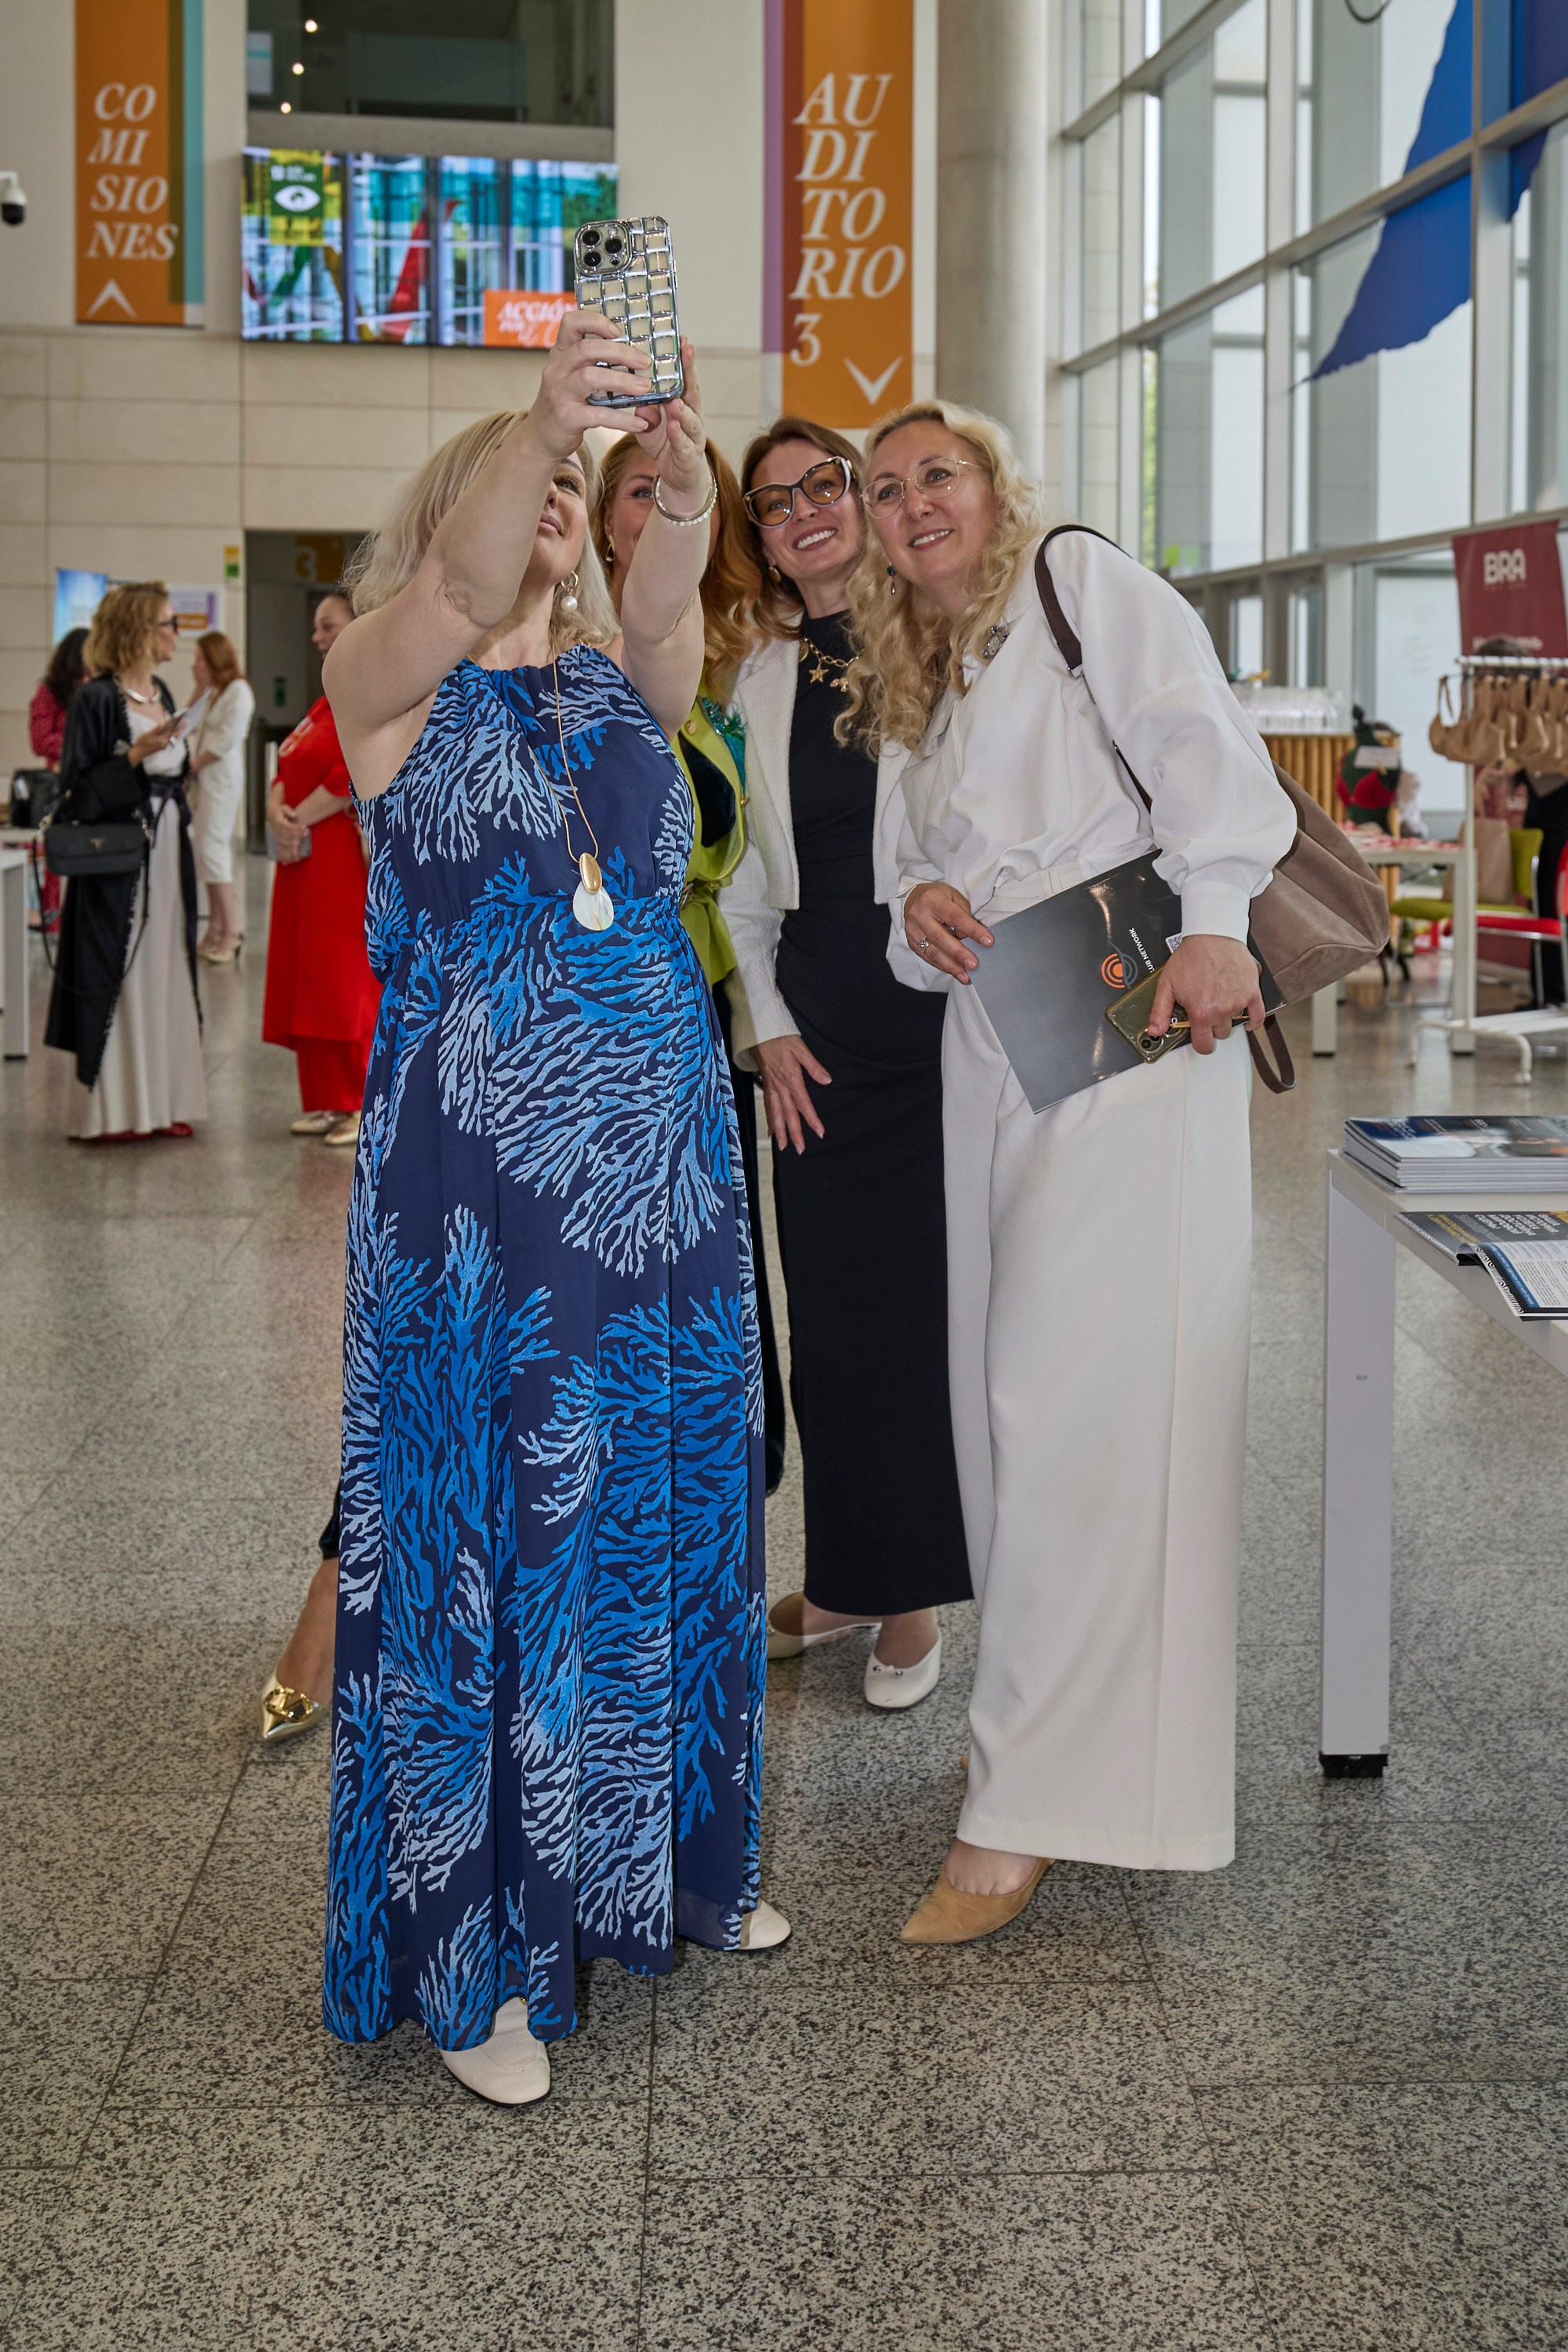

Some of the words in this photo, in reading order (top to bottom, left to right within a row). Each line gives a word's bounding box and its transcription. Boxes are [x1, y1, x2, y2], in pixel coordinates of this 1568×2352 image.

[93, 82, 157, 122] CO
[792, 72, 893, 127] AU
[87, 128, 151, 165] MI
[794, 129, 877, 182] DI
[89, 173, 169, 214] SIO
[801, 187, 887, 241] TO
[85, 221, 180, 262] NES
[789, 245, 906, 300] RIO
[790, 313, 822, 366] 3
[1483, 548, 1526, 584] BRA
[1129, 927, 1149, 960] NETWORK
[1145, 960, 1155, 973] LUB
